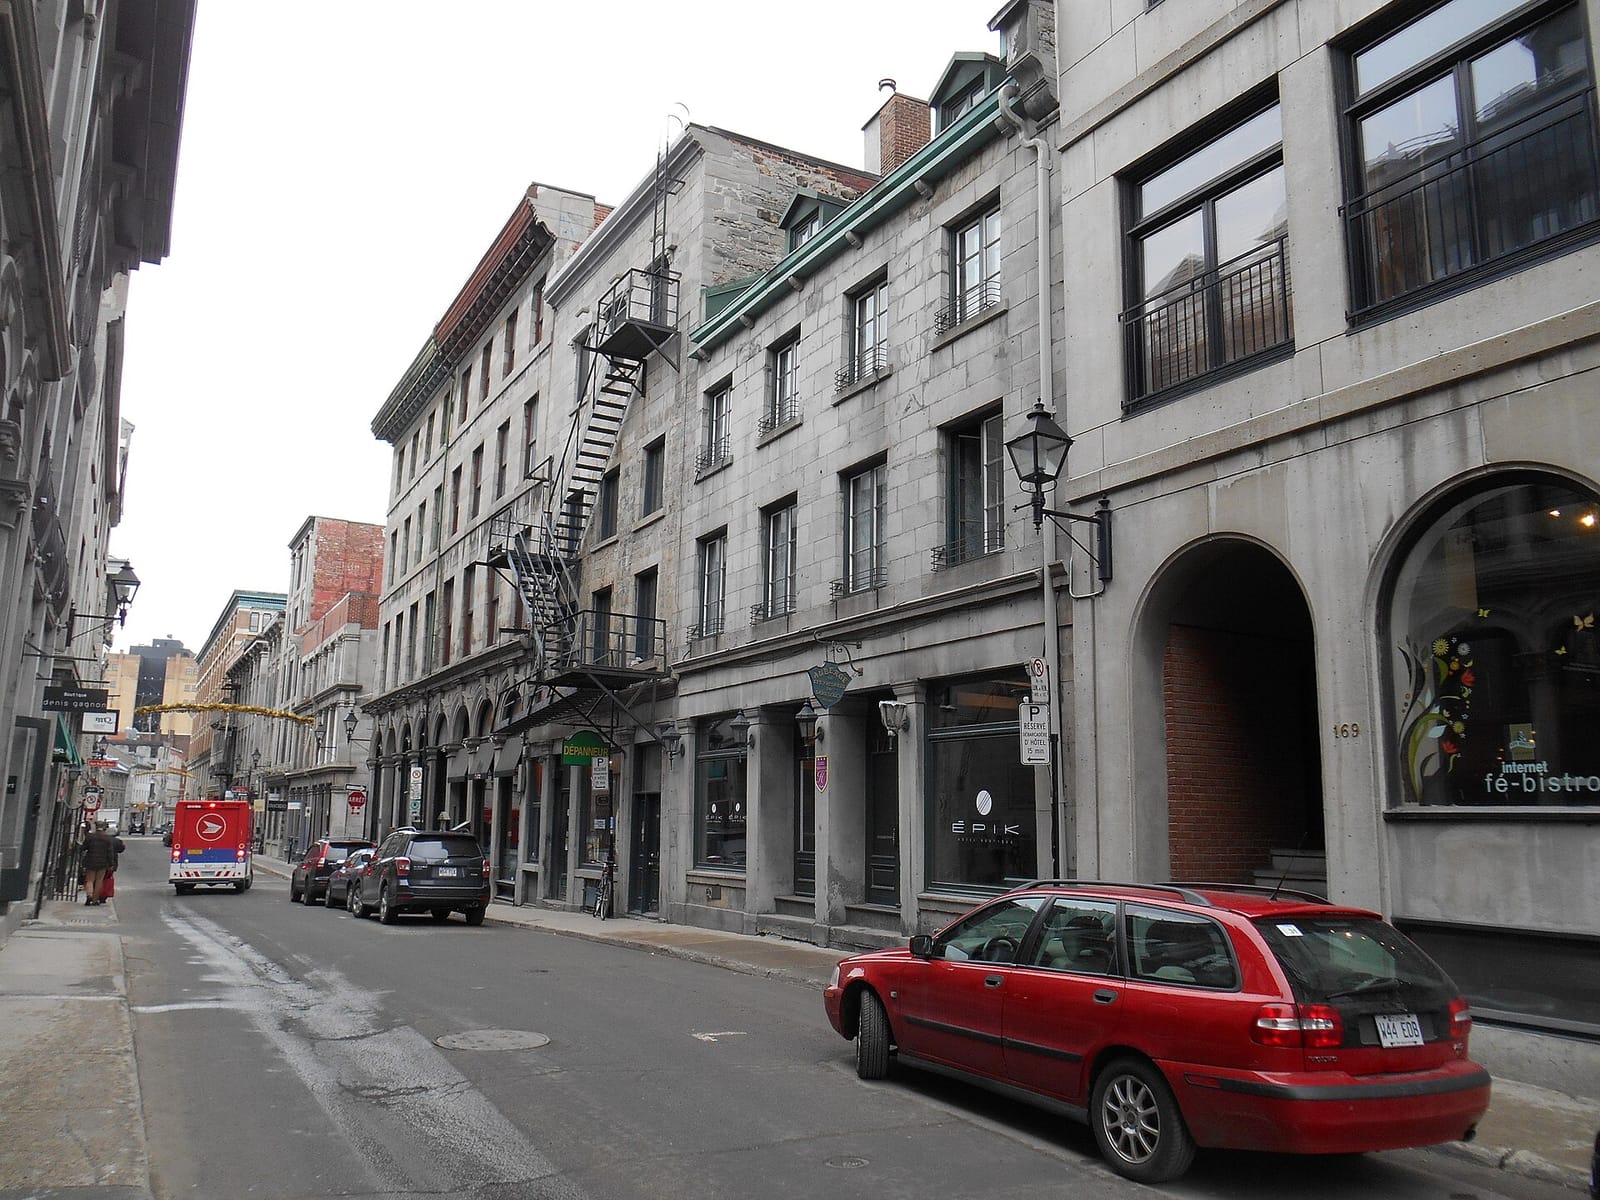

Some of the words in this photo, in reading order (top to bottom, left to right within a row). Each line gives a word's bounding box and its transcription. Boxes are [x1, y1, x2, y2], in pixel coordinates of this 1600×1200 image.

[814, 668, 848, 683] AUBERGE
[1030, 706, 1040, 721] P
[1333, 723, 1359, 738] 169
[1502, 761, 1548, 773] internet
[1484, 773, 1600, 792] fé-bistro
[952, 820, 1020, 835] ÉPIK
